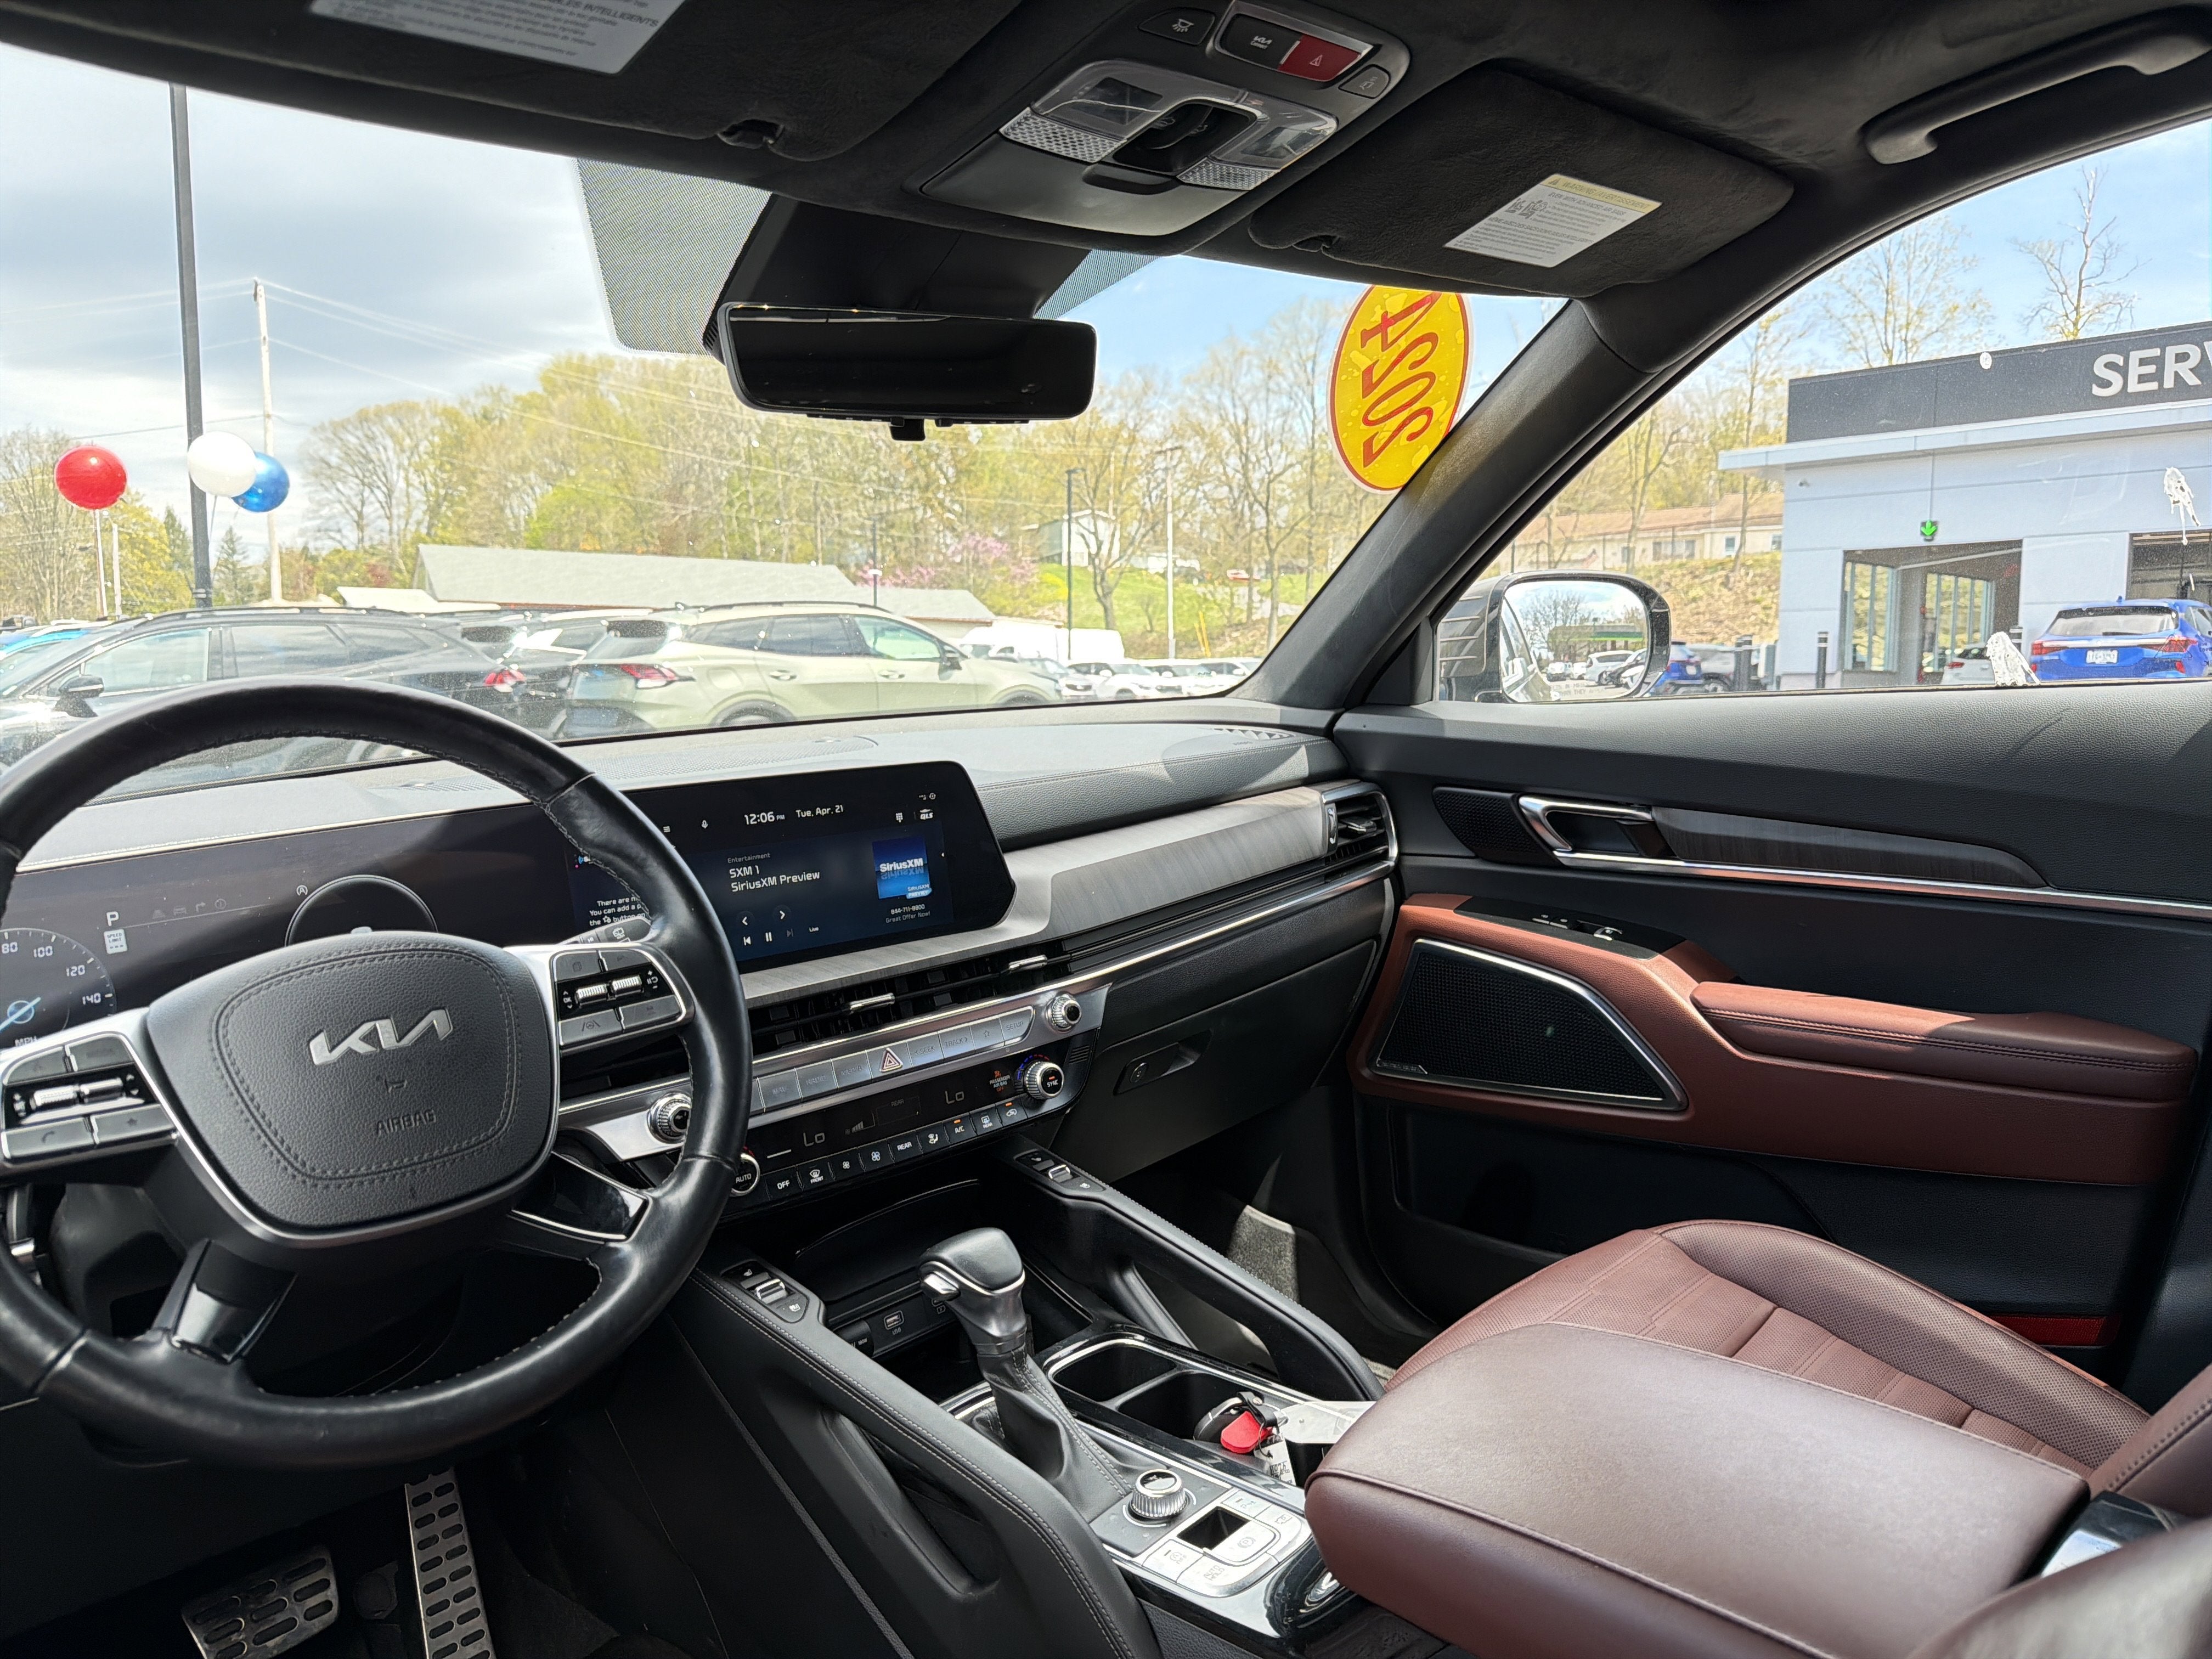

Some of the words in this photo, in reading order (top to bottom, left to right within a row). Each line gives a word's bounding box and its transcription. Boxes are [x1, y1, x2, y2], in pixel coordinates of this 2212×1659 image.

[1361, 291, 1441, 468] 2024
[744, 811, 775, 825] 12:06
[816, 807, 833, 816] Apr.
[835, 804, 843, 813] 21
[727, 853, 771, 864] Entertainment
[879, 857, 923, 872] SiriusXM
[729, 866, 753, 878] SXM
[755, 865, 760, 874] 1
[731, 876, 777, 892] SiriusXM
[780, 871, 820, 884] Preview
[106, 911, 119, 927] P
[1, 941, 18, 954] 80
[33, 945, 53, 958] 100
[66, 965, 86, 977] 120
[82, 992, 101, 1005] 140
[1006, 1021, 1023, 1030] SETUP
[309, 1008, 453, 1065] KIA
[1047, 1080, 1059, 1088] SYNC
[891, 1098, 904, 1107] REAR
[377, 1109, 436, 1137] AIRBAG
[955, 1125, 964, 1134] A/C
[897, 1142, 912, 1151] REAR
[735, 1173, 752, 1184] AUTO
[777, 1180, 791, 1189] OFF
